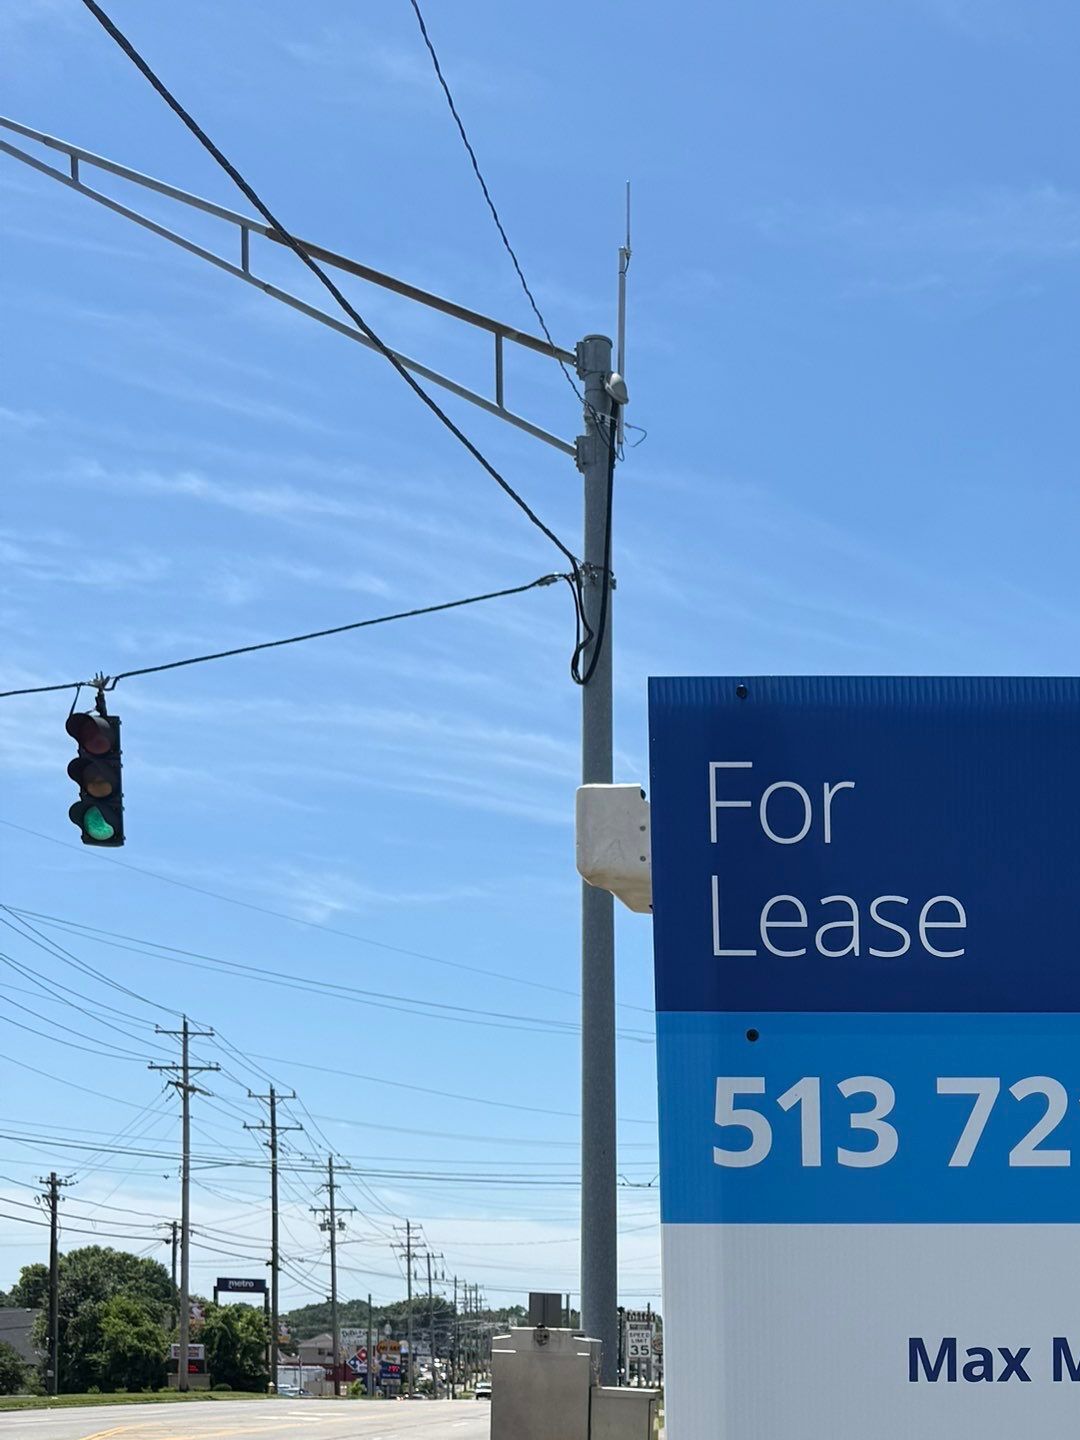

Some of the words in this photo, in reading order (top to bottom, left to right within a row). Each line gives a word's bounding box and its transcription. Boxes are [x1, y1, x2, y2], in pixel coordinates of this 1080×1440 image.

[708, 761, 855, 844] For
[712, 875, 967, 958] Lease
[713, 1076, 898, 1168] 513
[228, 1280, 254, 1289] metro
[630, 1345, 649, 1356] 35
[908, 1337, 1032, 1383] Max
